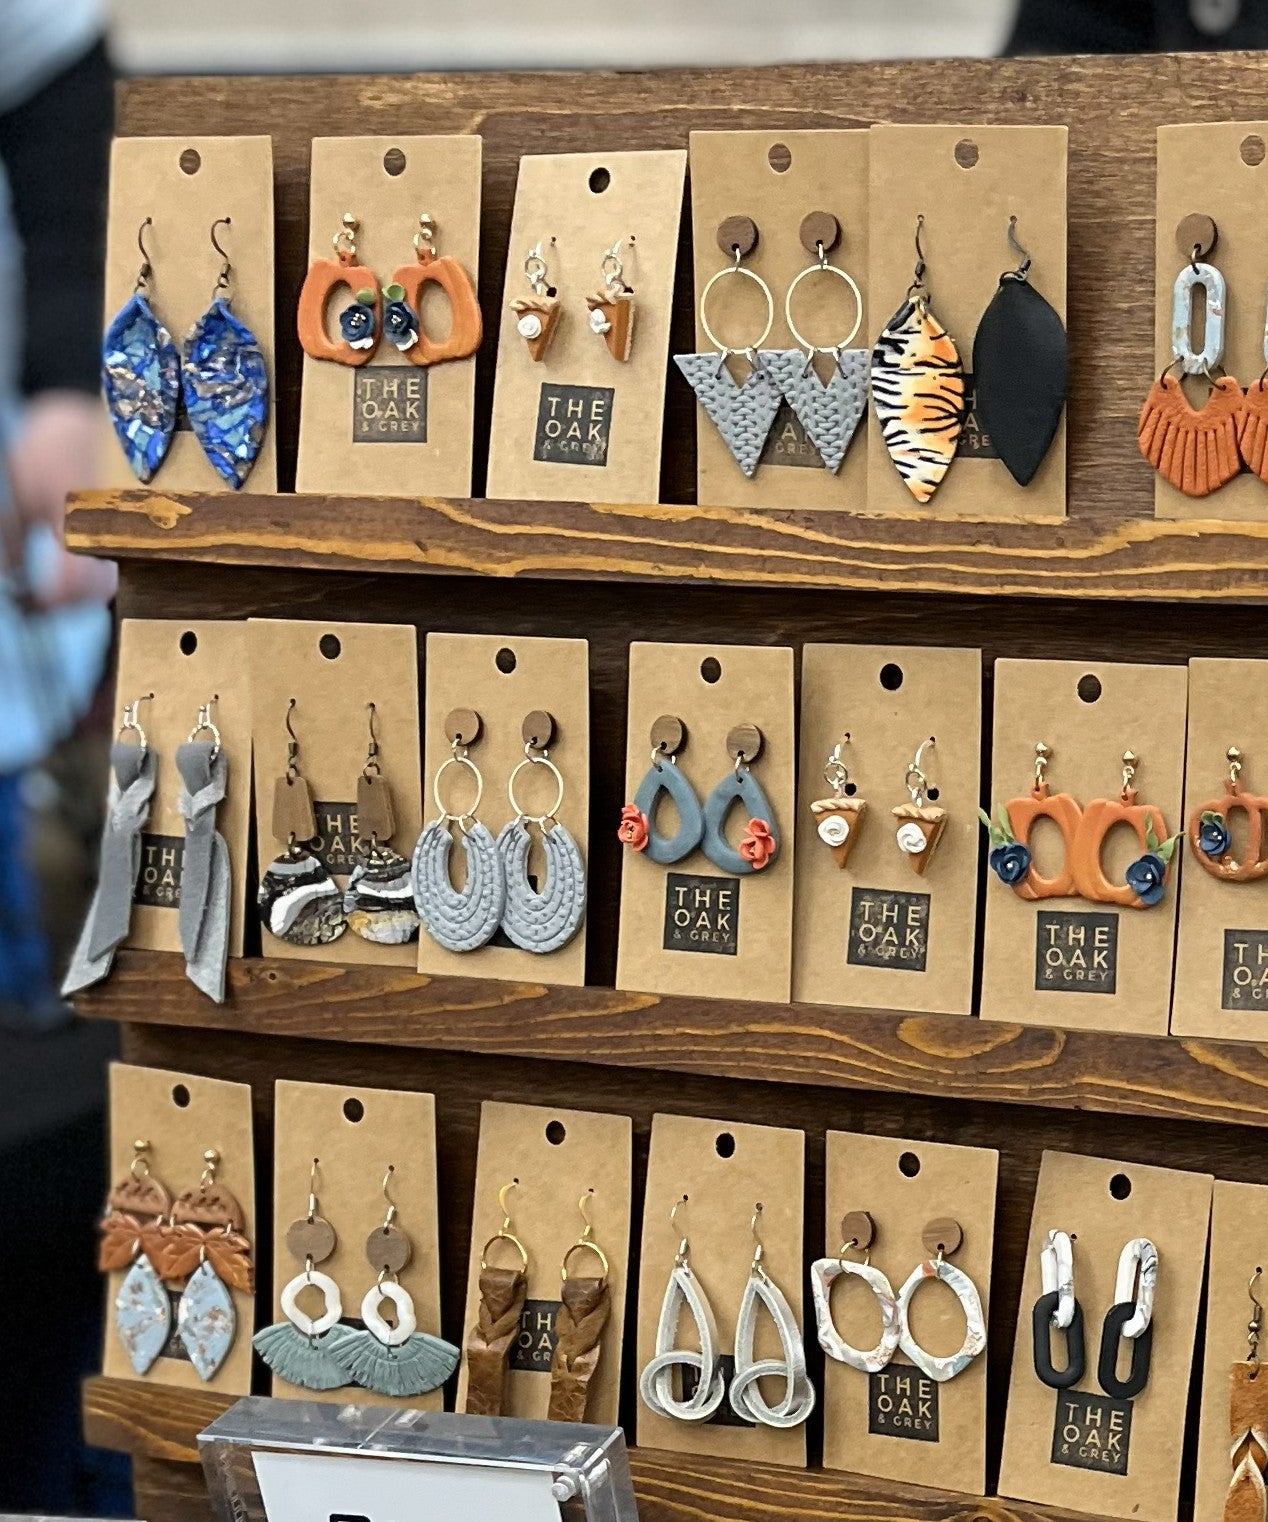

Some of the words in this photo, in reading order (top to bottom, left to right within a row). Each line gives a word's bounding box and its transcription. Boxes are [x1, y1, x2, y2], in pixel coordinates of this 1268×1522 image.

[362, 379, 421, 400] THE
[362, 401, 420, 419] OAK
[548, 397, 606, 421] THE
[379, 421, 419, 433] GREY
[545, 420, 603, 442] OAK
[960, 433, 991, 449] GRE
[327, 814, 359, 834] HE
[146, 846, 176, 867] TH
[326, 853, 355, 865] GRE
[144, 867, 176, 887] OA
[156, 888, 181, 901] GRE
[675, 886, 732, 911] THE
[674, 909, 730, 932] OAK
[861, 902, 922, 926] THE
[689, 930, 730, 943] GREY
[860, 924, 920, 947] OAK
[1046, 924, 1109, 948] THE
[1046, 948, 1108, 969] OAK
[1063, 969, 1108, 981] GREY
[1232, 988, 1241, 999] &
[522, 1311, 551, 1331] TH
[520, 1332, 552, 1350] OA
[877, 1373, 932, 1399] THE
[877, 1394, 932, 1419] OAK
[1065, 1402, 1124, 1431] THE
[892, 1416, 932, 1431] GREY
[1063, 1424, 1122, 1452] OAK
[1079, 1447, 1121, 1464] GREY
